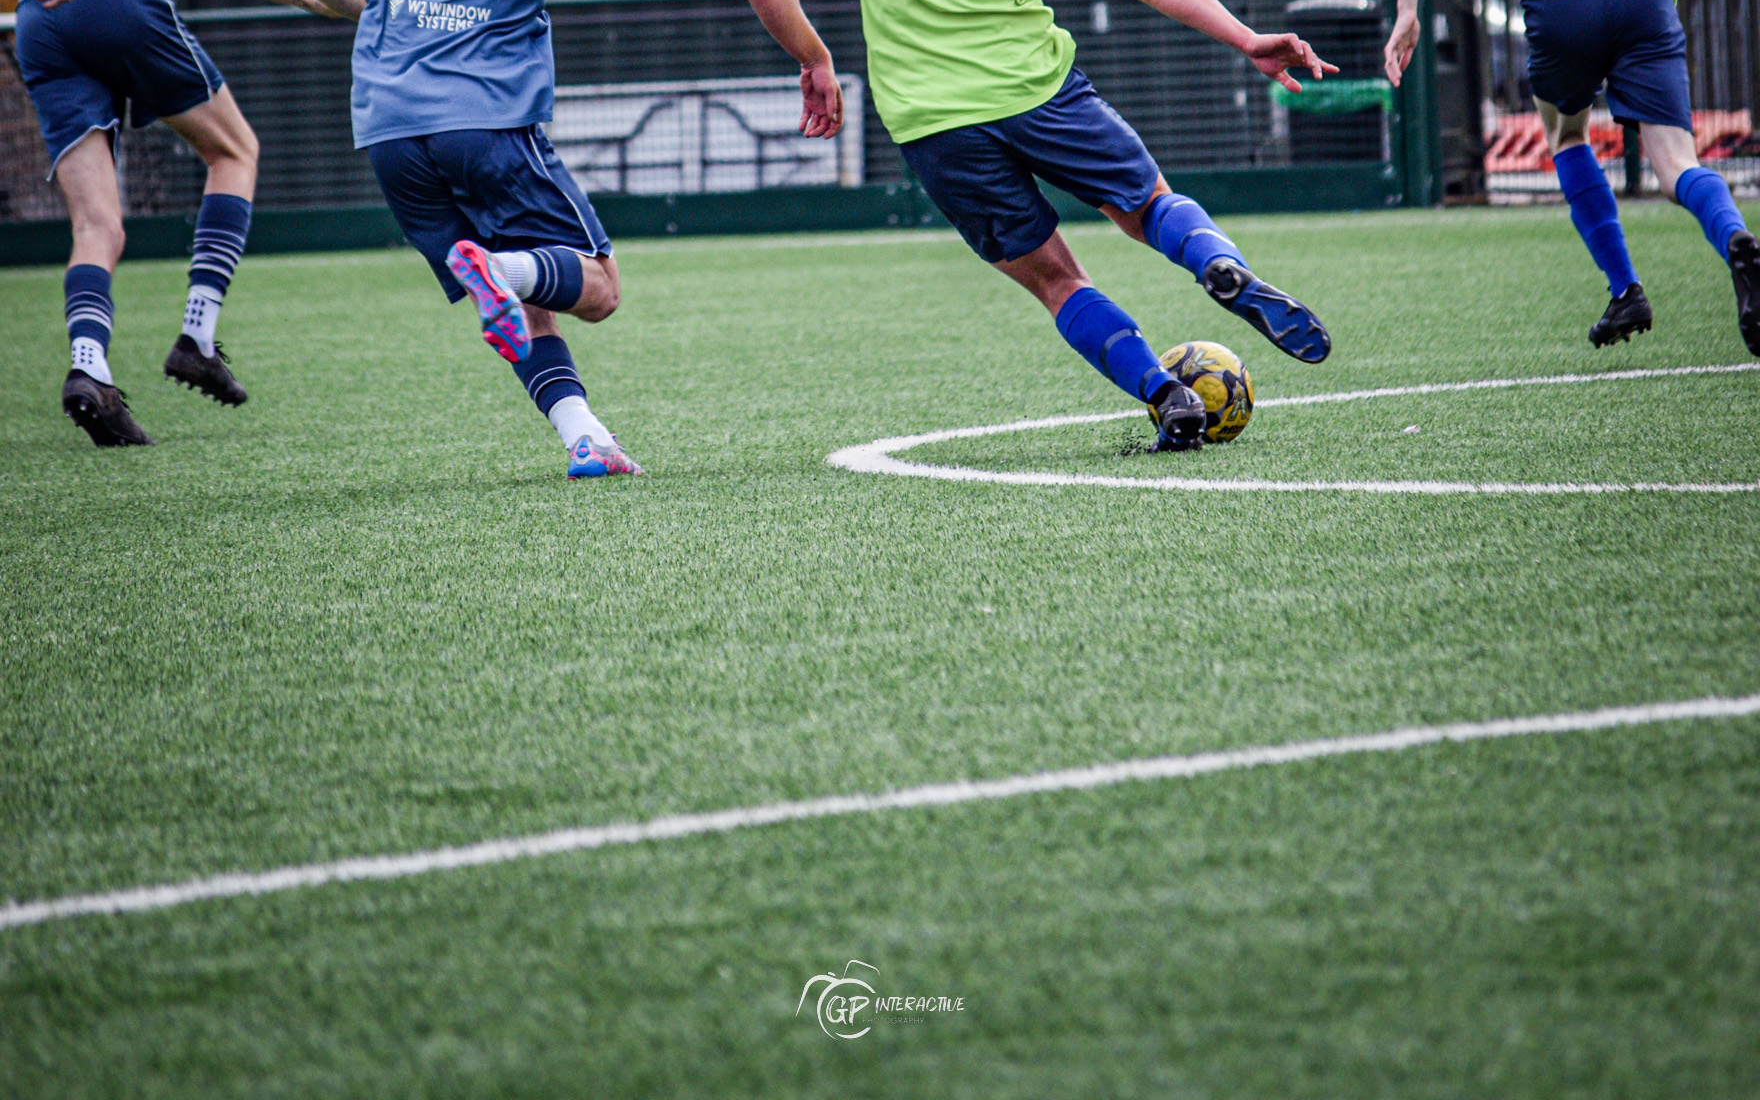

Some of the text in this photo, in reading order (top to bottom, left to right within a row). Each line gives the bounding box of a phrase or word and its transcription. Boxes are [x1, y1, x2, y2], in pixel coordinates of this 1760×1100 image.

[407, 0, 491, 22] W2 WINDOW
[416, 14, 475, 32] SYSTEMS
